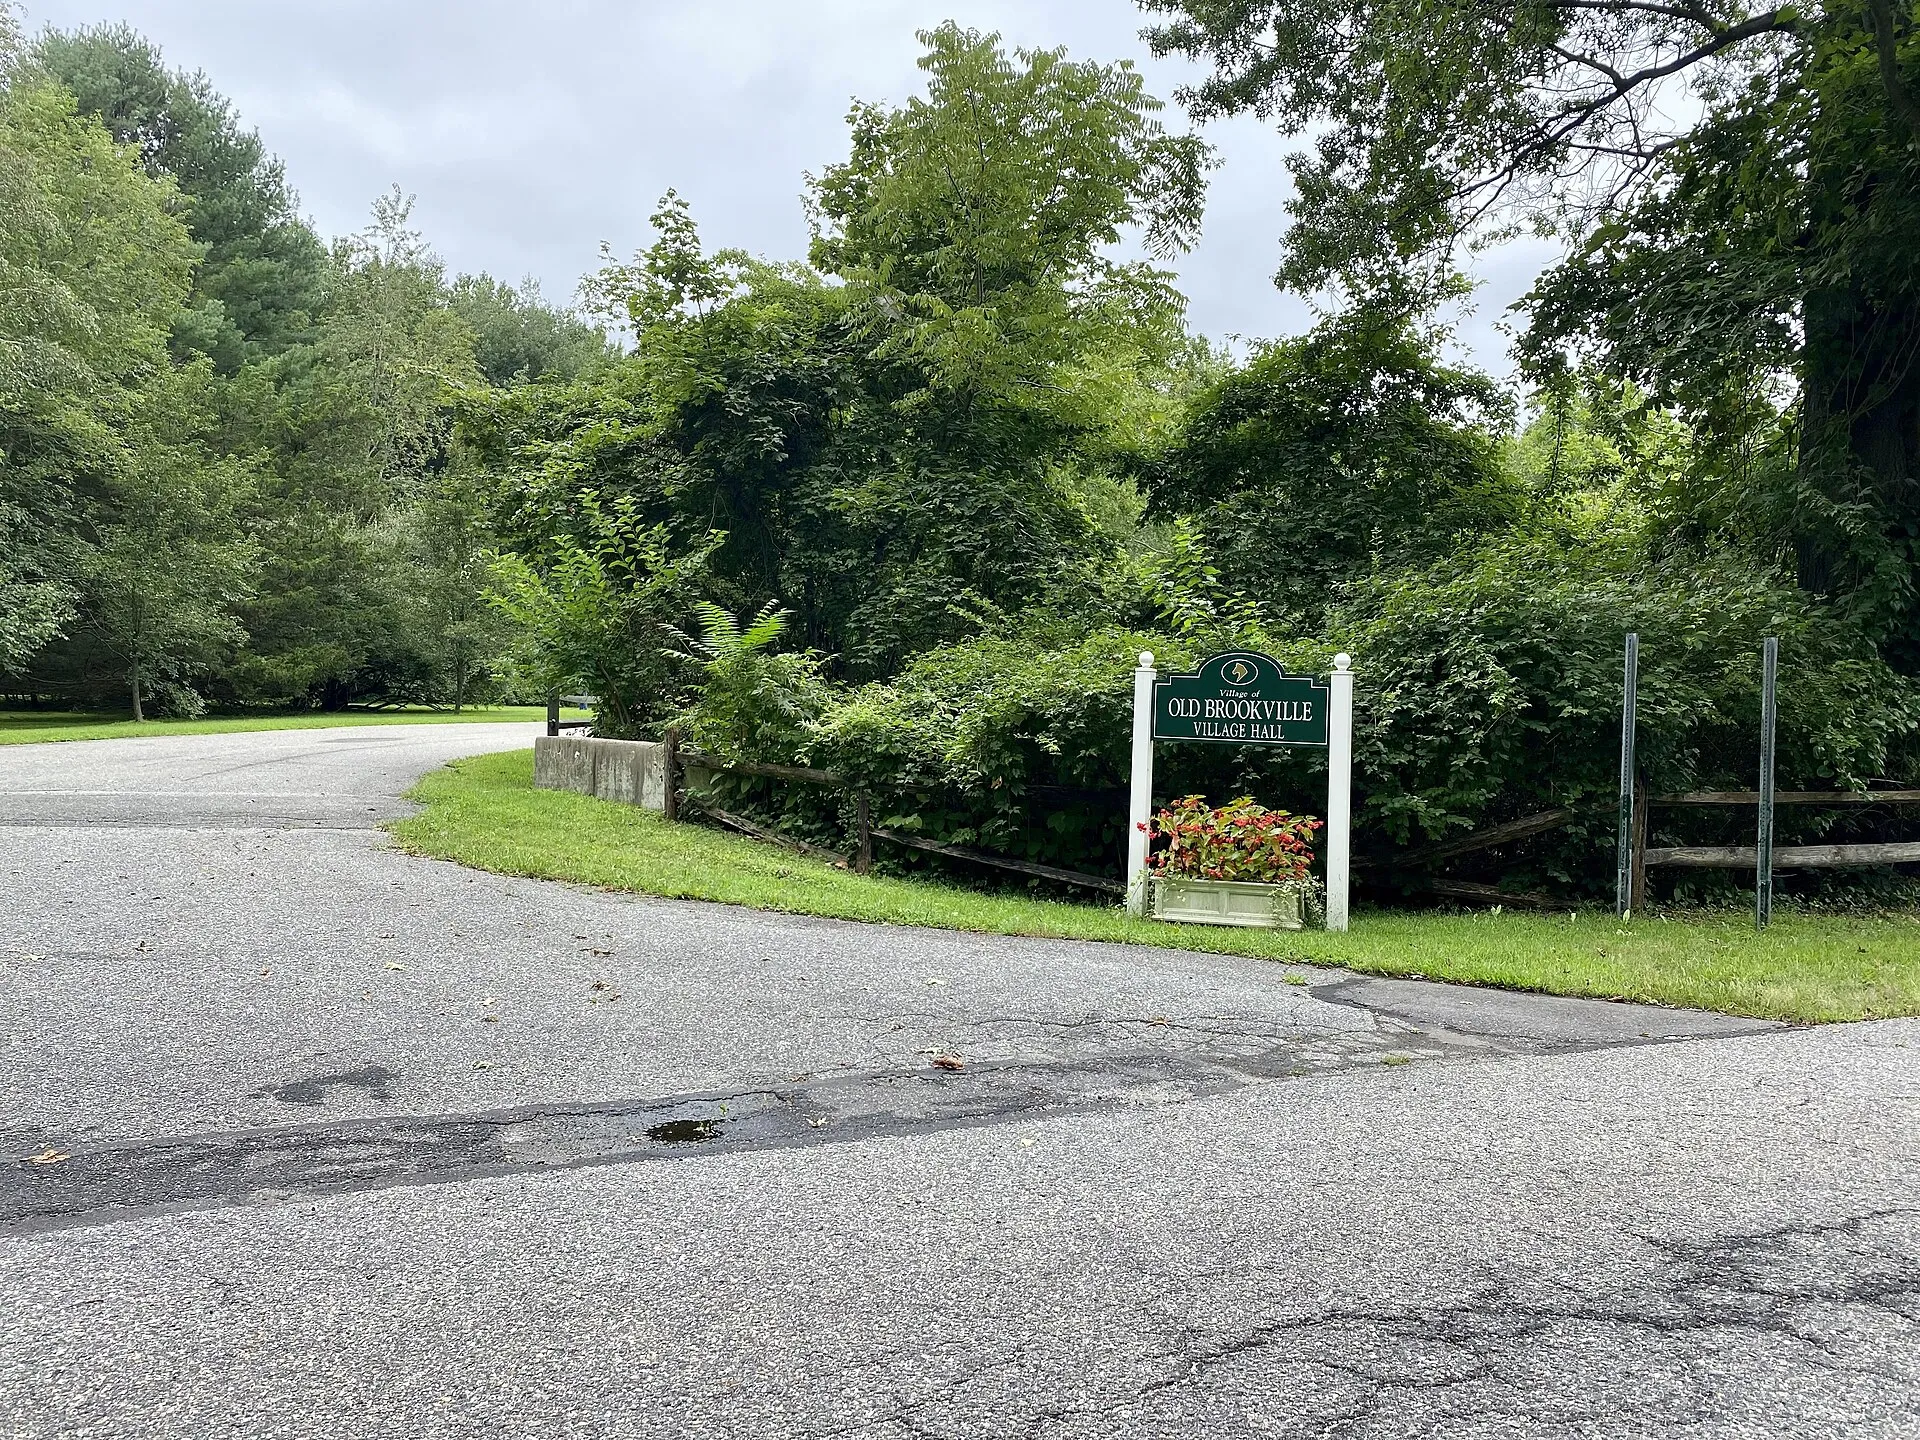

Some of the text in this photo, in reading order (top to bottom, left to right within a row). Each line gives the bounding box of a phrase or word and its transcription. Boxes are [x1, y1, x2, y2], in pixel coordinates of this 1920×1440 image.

[1219, 689, 1261, 698] Village of
[1168, 697, 1313, 722] OLD BROOKVILLE
[1193, 721, 1285, 739] VILLAGE HALL
